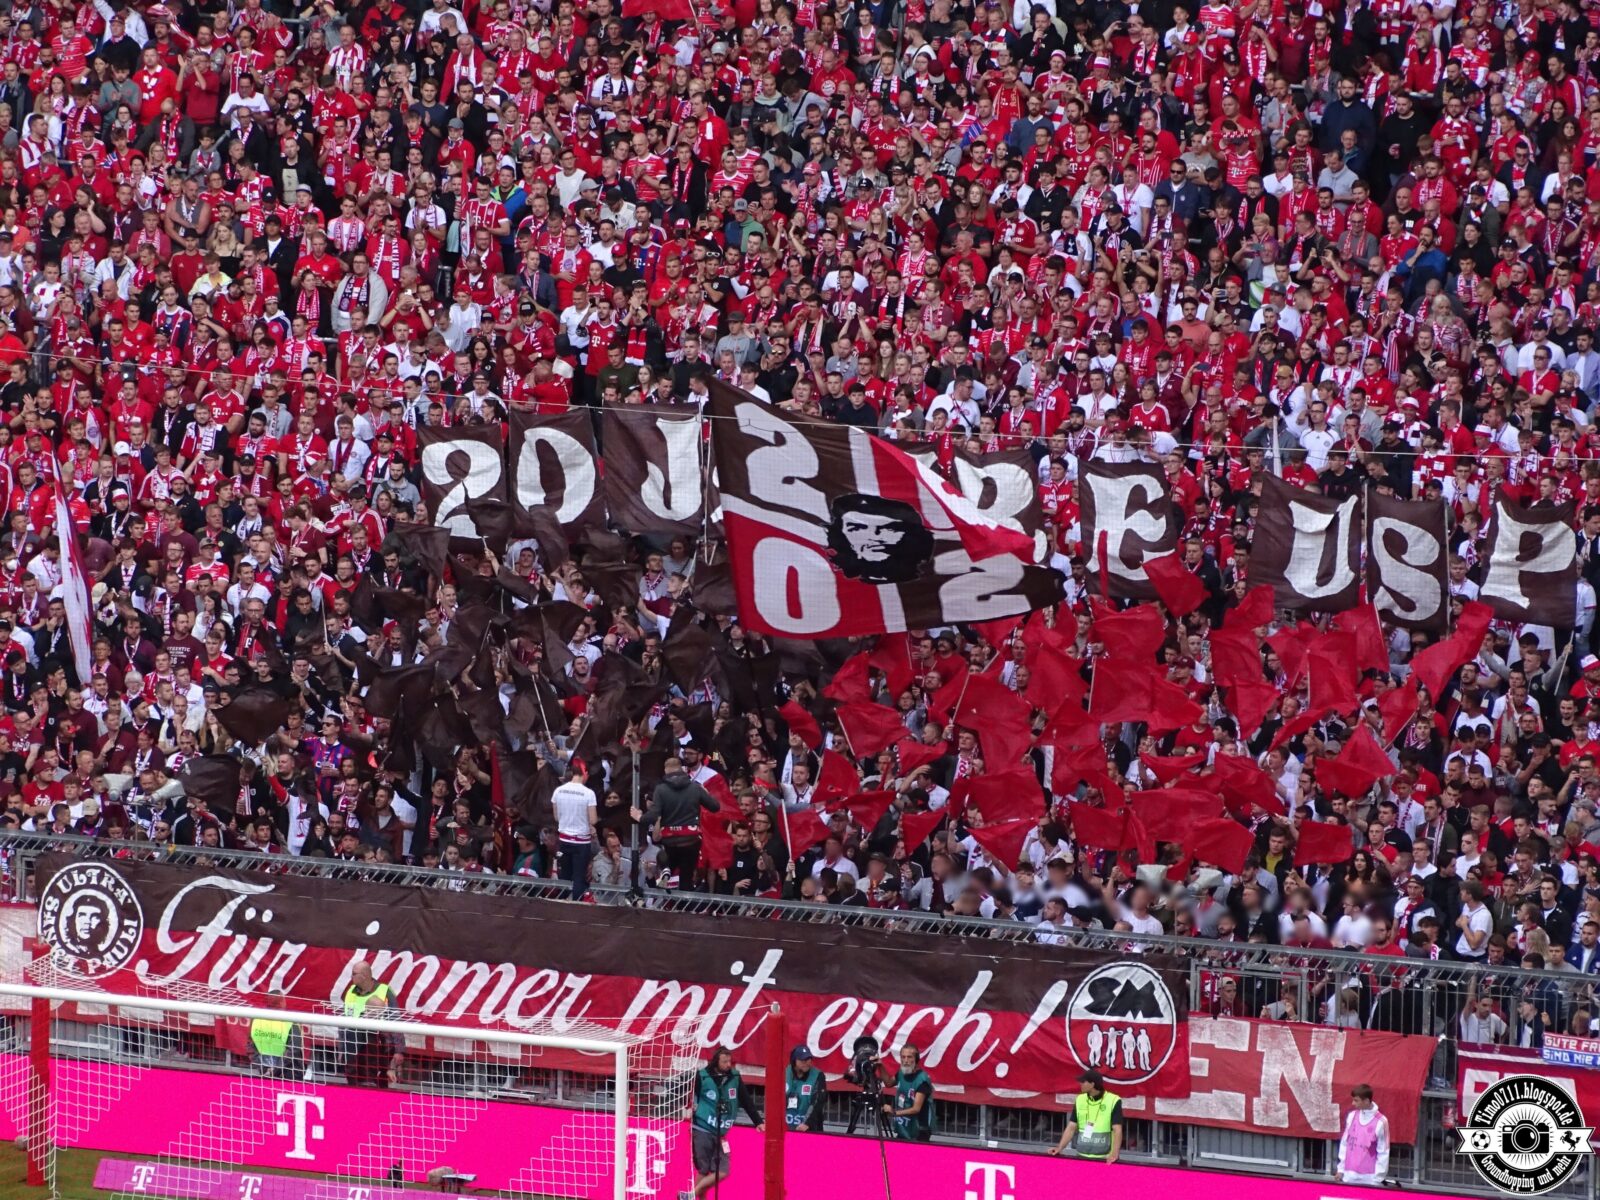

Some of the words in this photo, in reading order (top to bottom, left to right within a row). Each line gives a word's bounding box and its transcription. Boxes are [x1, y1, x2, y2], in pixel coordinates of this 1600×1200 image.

[87, 919, 138, 974] PAULI
[136, 875, 307, 997] Für
[330, 920, 595, 1032] immer
[613, 948, 783, 1051] mit
[806, 970, 1069, 1078] euch!
[276, 1093, 325, 1161] T
